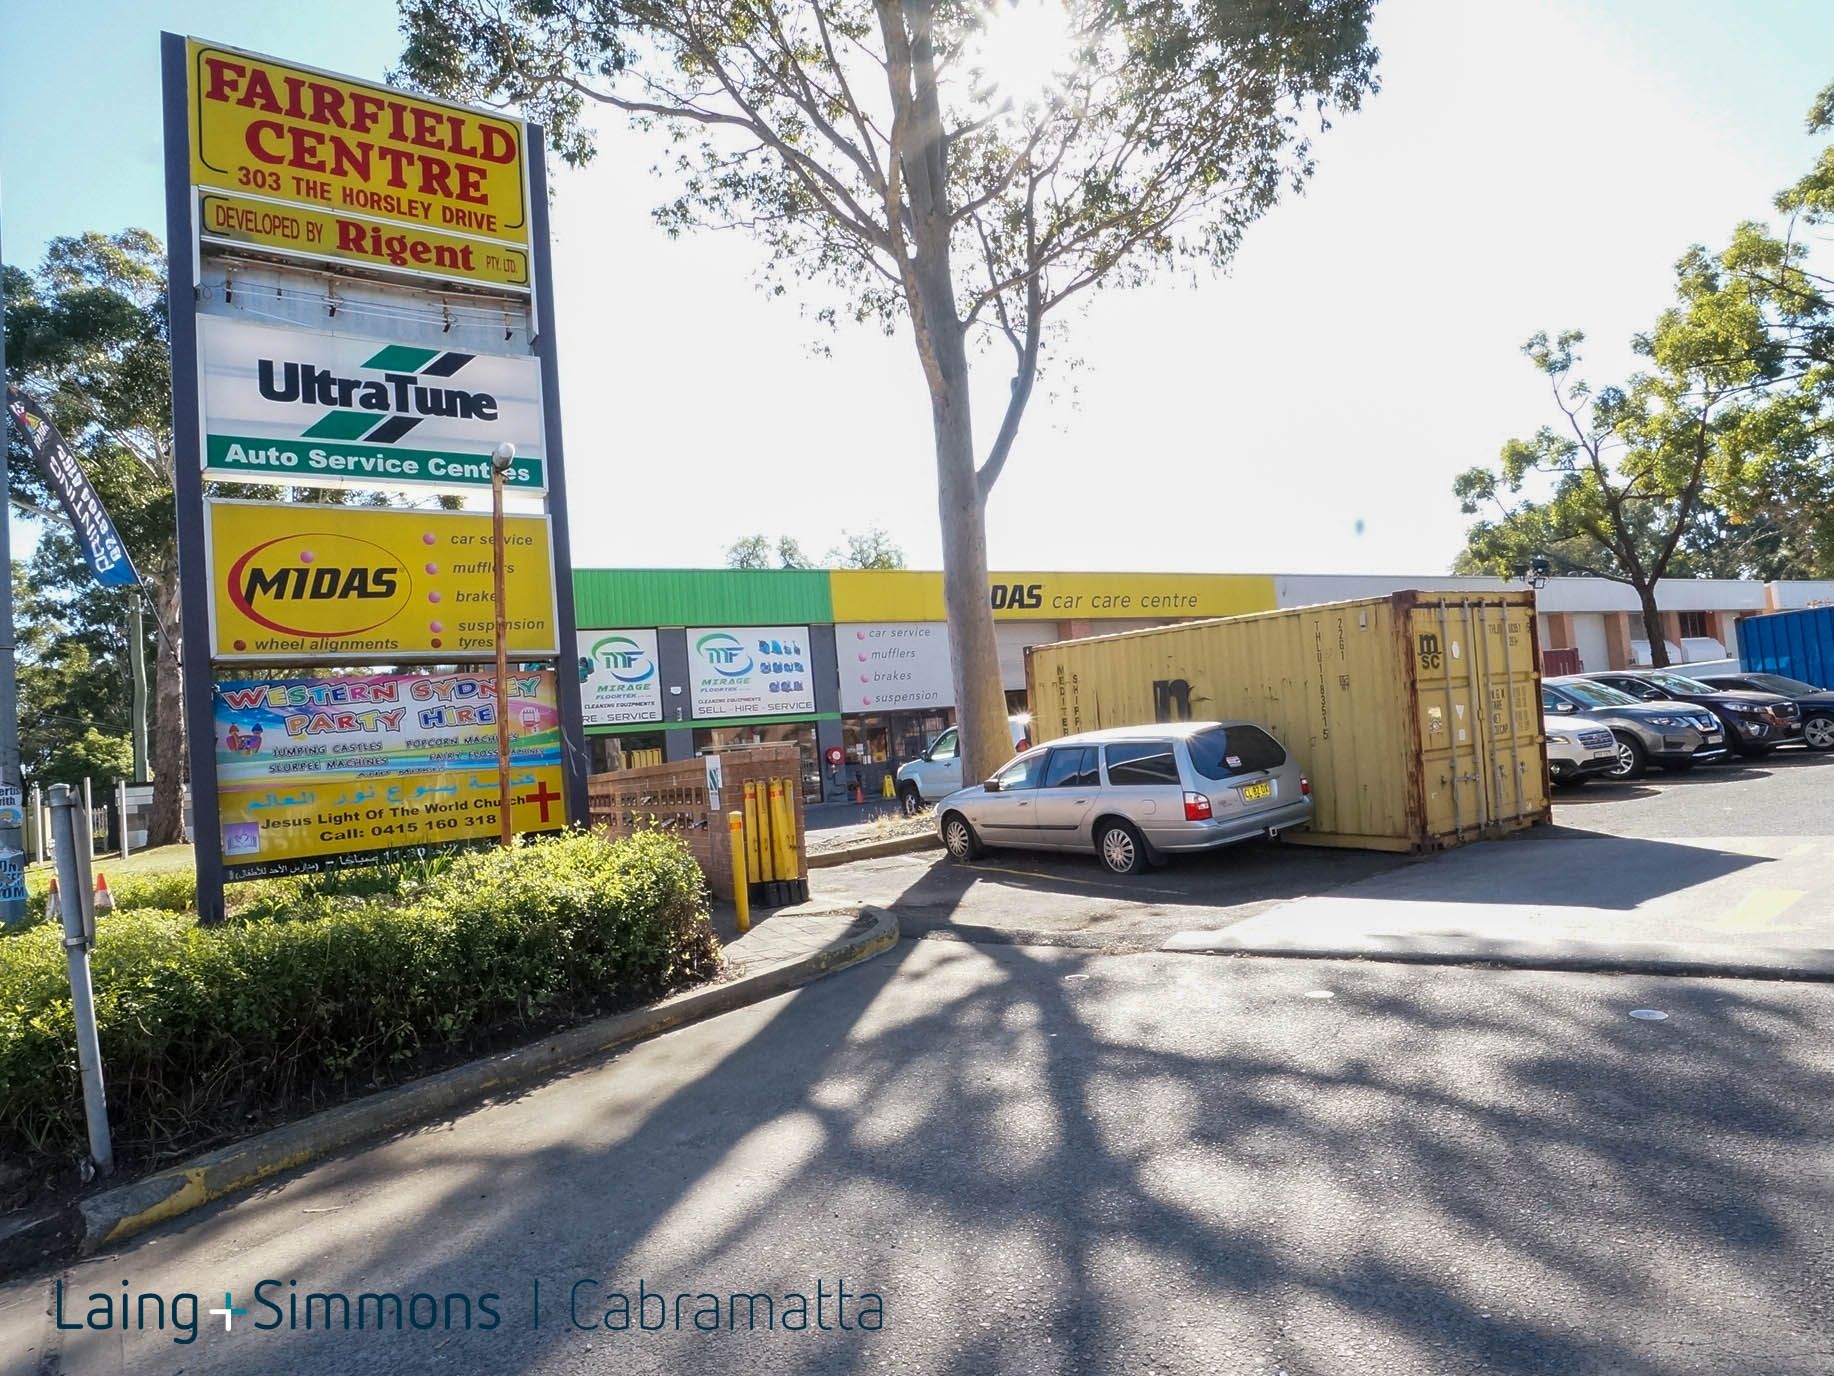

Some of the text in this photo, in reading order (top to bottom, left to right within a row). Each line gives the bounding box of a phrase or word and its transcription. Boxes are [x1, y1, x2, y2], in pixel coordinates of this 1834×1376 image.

[205, 57, 516, 165] FAIRFIELD
[245, 120, 489, 206] CENTRE
[238, 166, 498, 232] 303 THE HORSLEY DRIVE
[216, 205, 300, 240] DEVELOPED
[306, 220, 323, 243] BY
[336, 219, 476, 272] Rigent
[257, 358, 499, 422] UltraTune
[224, 443, 530, 482] Auto Service Centes
[49, 456, 115, 574] PRINTING
[450, 534, 533, 545] car sevice
[453, 561, 515, 574] muffls
[244, 567, 398, 609] MIDAS
[455, 590, 497, 602] brake
[991, 584, 1199, 610] DAS car care centre
[458, 618, 545, 633] suspnsion
[868, 627, 931, 638] car service
[255, 637, 399, 653] wheel alignments
[459, 637, 494, 649] tyres
[871, 648, 916, 660] mufflers
[1421, 655, 1440, 669] SC
[873, 670, 912, 681] brakes
[222, 675, 541, 711] WESTERN SYDNEY
[597, 683, 652, 693] MIRAGE
[875, 690, 938, 704] suspension
[698, 706, 727, 715] SELL
[735, 704, 758, 712] HIRE
[767, 701, 813, 711] SERVICE
[284, 703, 497, 736] PARTY HIRE
[583, 714, 598, 723] RE
[607, 711, 657, 722] SERVICE
[405, 735, 459, 748] POPCORN
[273, 741, 384, 758] JUMPING CASTLES
[326, 757, 388, 770] MACHINES
[261, 796, 526, 830] Jesus Light Of The World Chuch
[319, 814, 497, 842] Call: 0415 160 318
